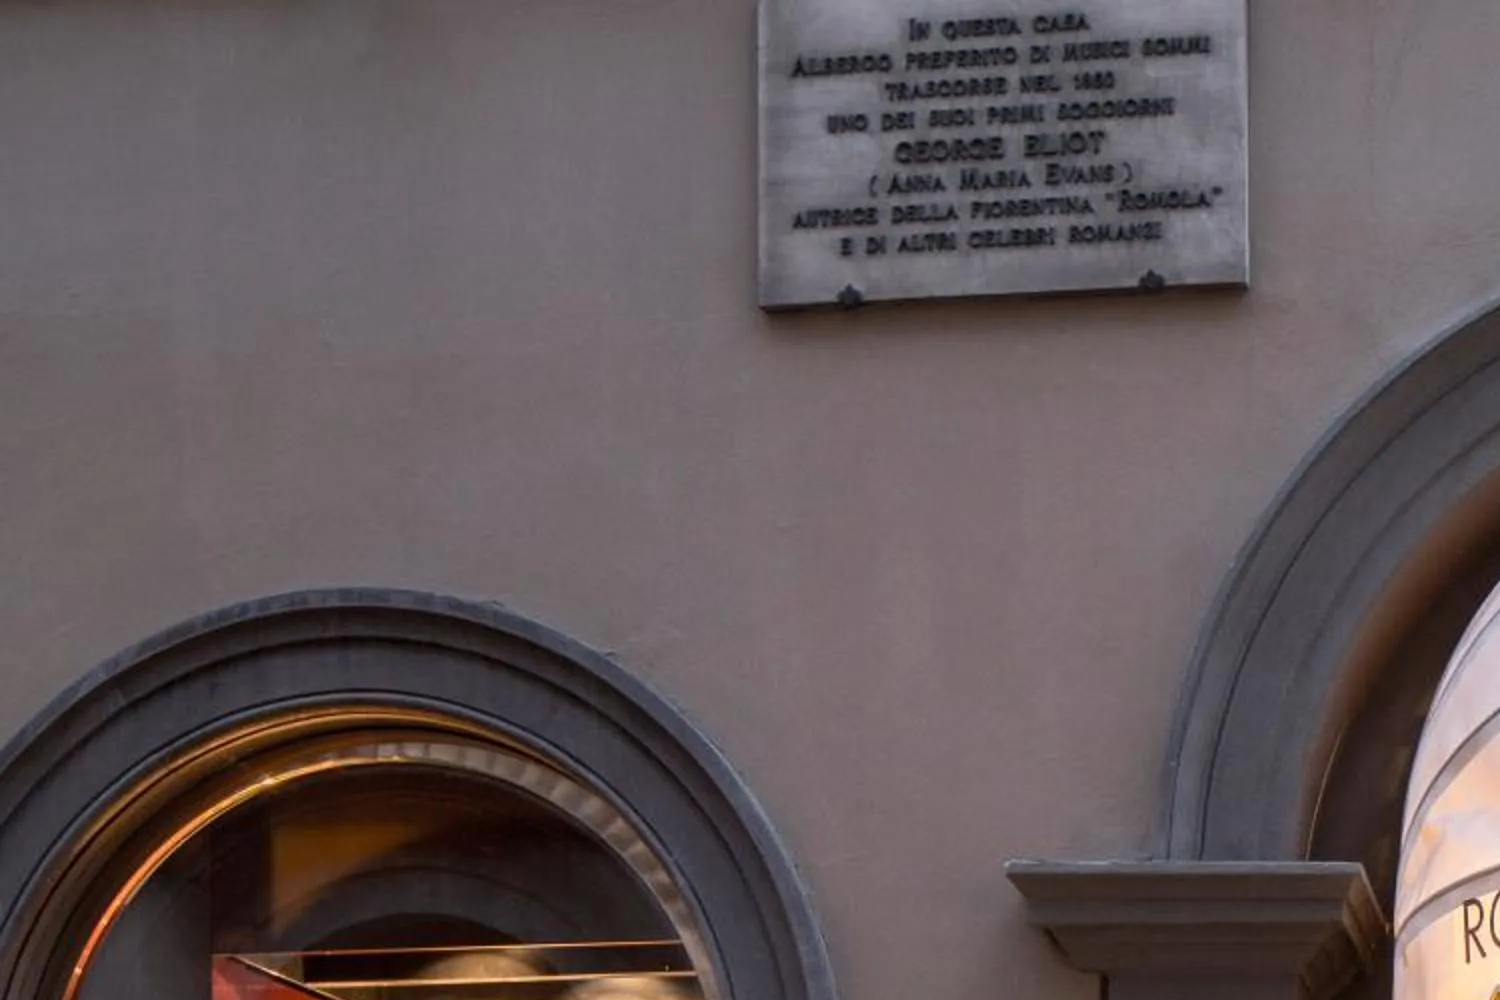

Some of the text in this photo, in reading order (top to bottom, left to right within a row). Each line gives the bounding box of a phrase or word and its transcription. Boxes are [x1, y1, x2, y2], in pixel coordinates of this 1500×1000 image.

[941, 17, 1022, 41] QUESTA
[1033, 13, 1091, 34] CASA
[791, 53, 893, 78] ALBERGO
[905, 46, 1018, 71] PREFERITO
[1030, 45, 1051, 64] DI
[884, 76, 1007, 102] TRASCORSE
[1019, 74, 1062, 94] NEL
[827, 97, 1175, 134] UNO DEI SUOI PRIMI SOGGIORNI
[895, 131, 1105, 164] GEORGE ELIOT
[959, 167, 1032, 191] MARIA
[792, 206, 879, 229] AUTRICE
[890, 203, 959, 225] DELLA
[970, 196, 1095, 221] FIORENTINA
[840, 221, 1163, 257] E DI ALTRI CELEBRI ROMANZI
